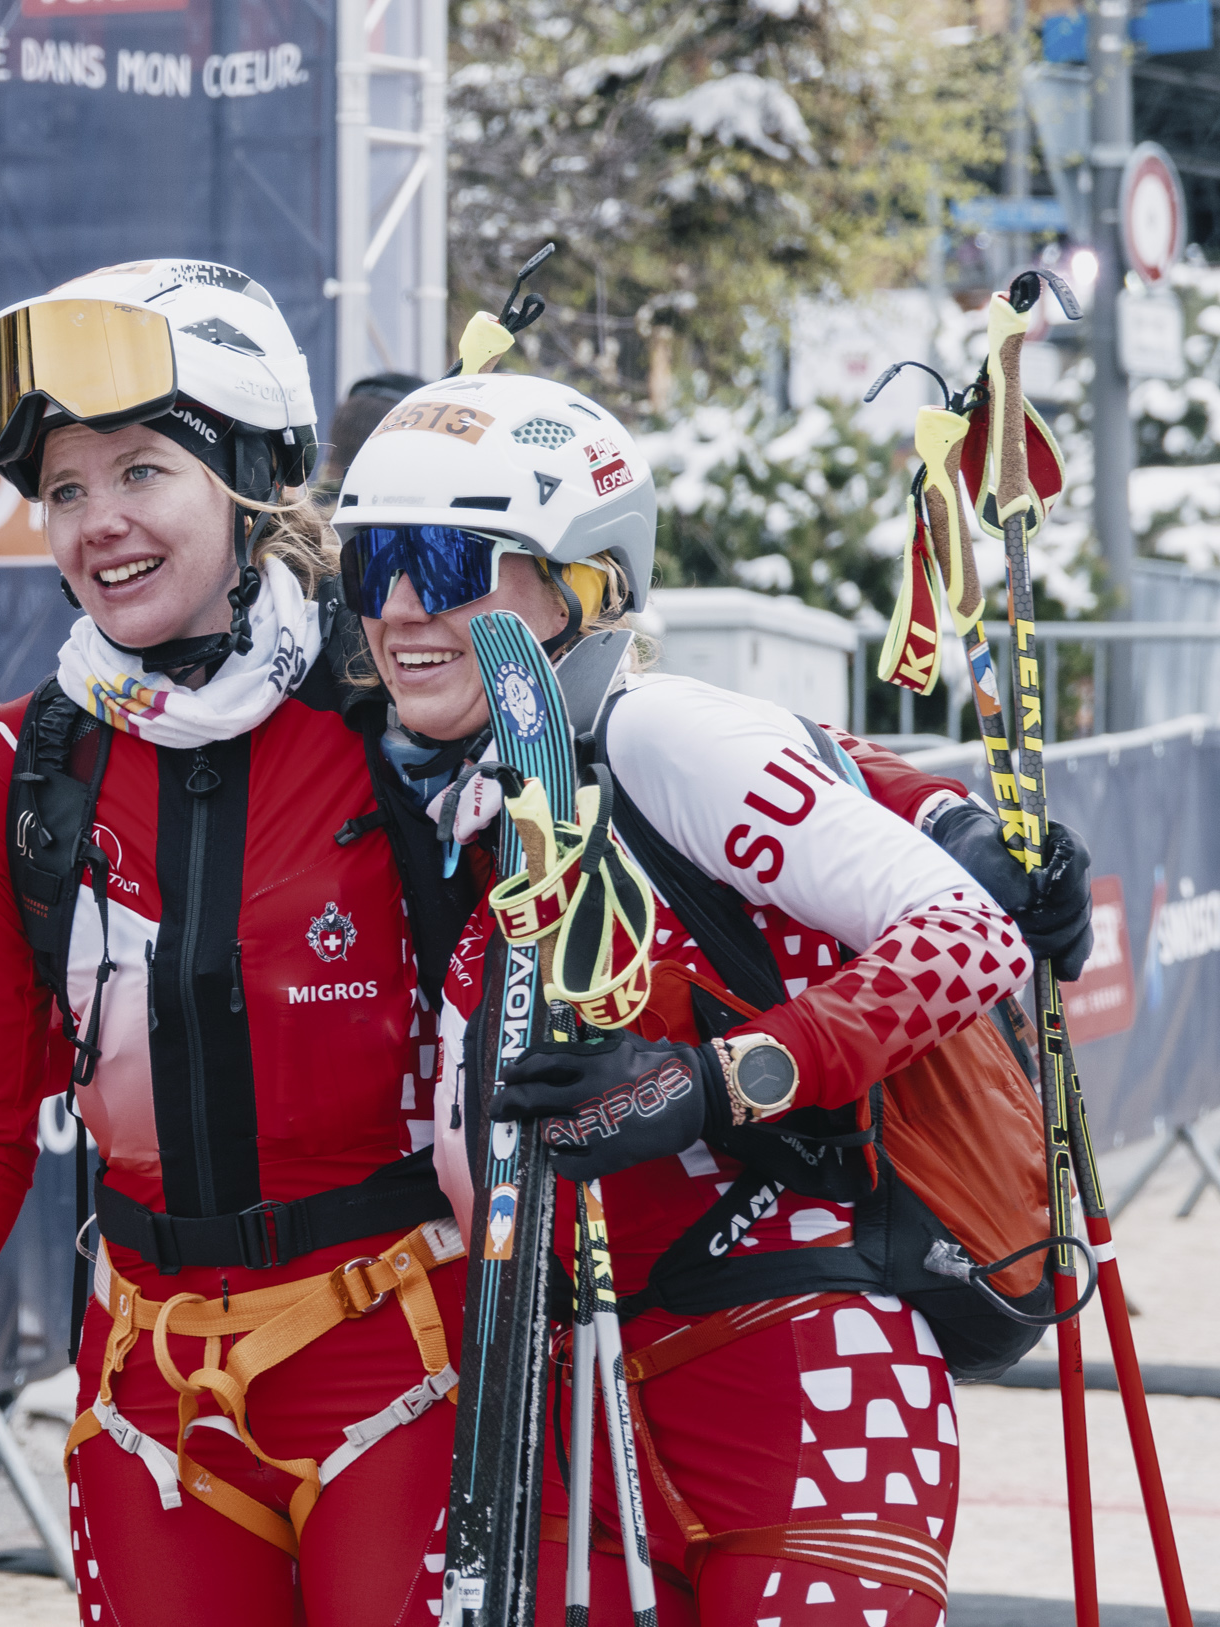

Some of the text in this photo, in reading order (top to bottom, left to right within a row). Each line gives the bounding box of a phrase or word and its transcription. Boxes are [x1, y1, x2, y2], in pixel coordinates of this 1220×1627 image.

[21, 38, 107, 89] DANS
[118, 48, 191, 98] MON
[596, 466, 632, 495] LEYSIN
[495, 662, 535, 712] AMICALE
[1016, 618, 1044, 752] LEKI
[288, 980, 378, 1005] MIGROS
